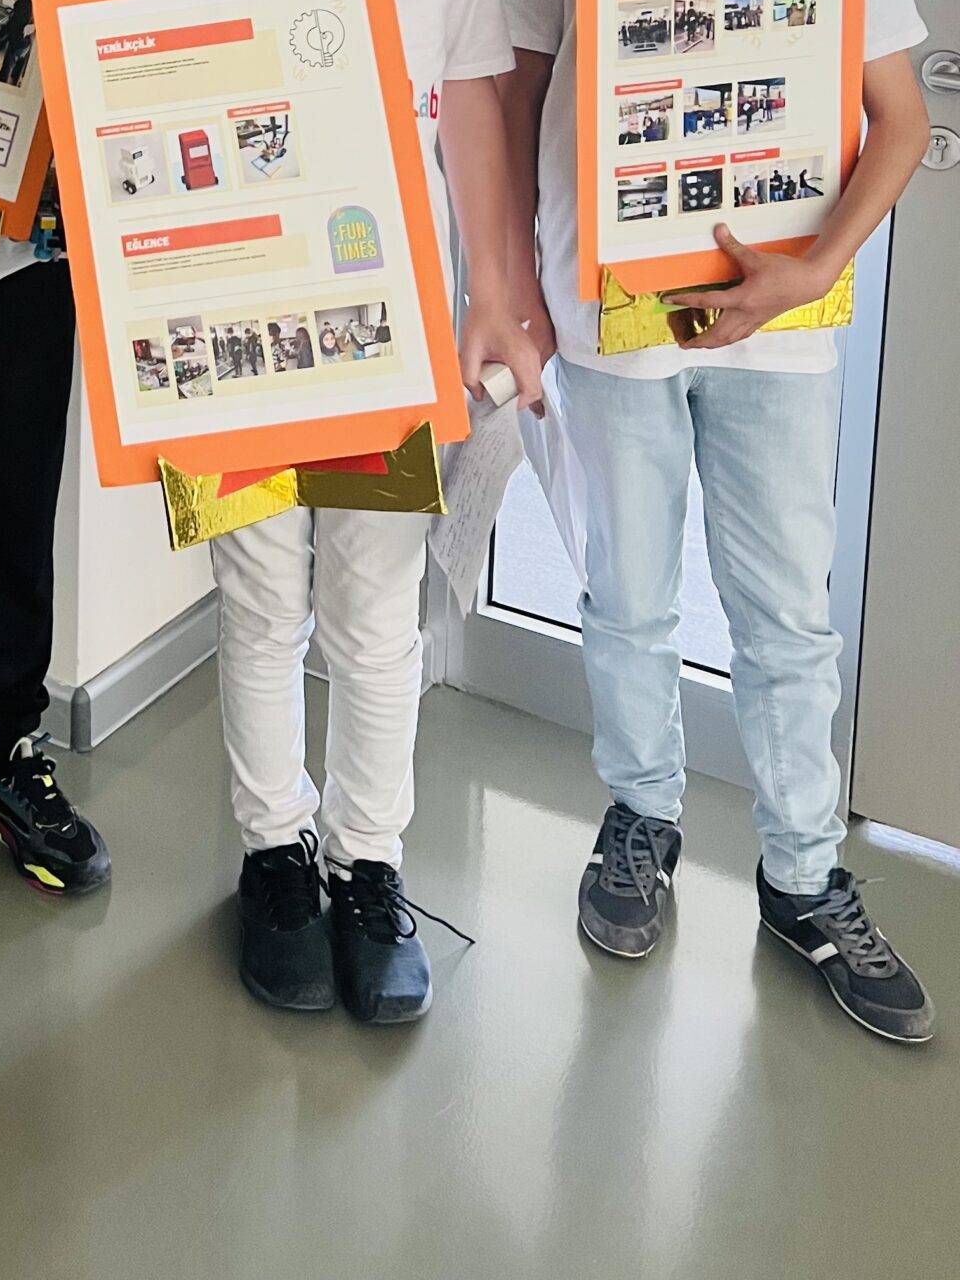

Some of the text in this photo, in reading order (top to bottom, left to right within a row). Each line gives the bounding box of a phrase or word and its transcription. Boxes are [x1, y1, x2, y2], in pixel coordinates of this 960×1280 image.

[97, 36, 156, 55] YENİLİKÇİLİK
[338, 221, 367, 241] FUN
[125, 235, 170, 251] EĞLENCE
[334, 240, 377, 261] TIMES
